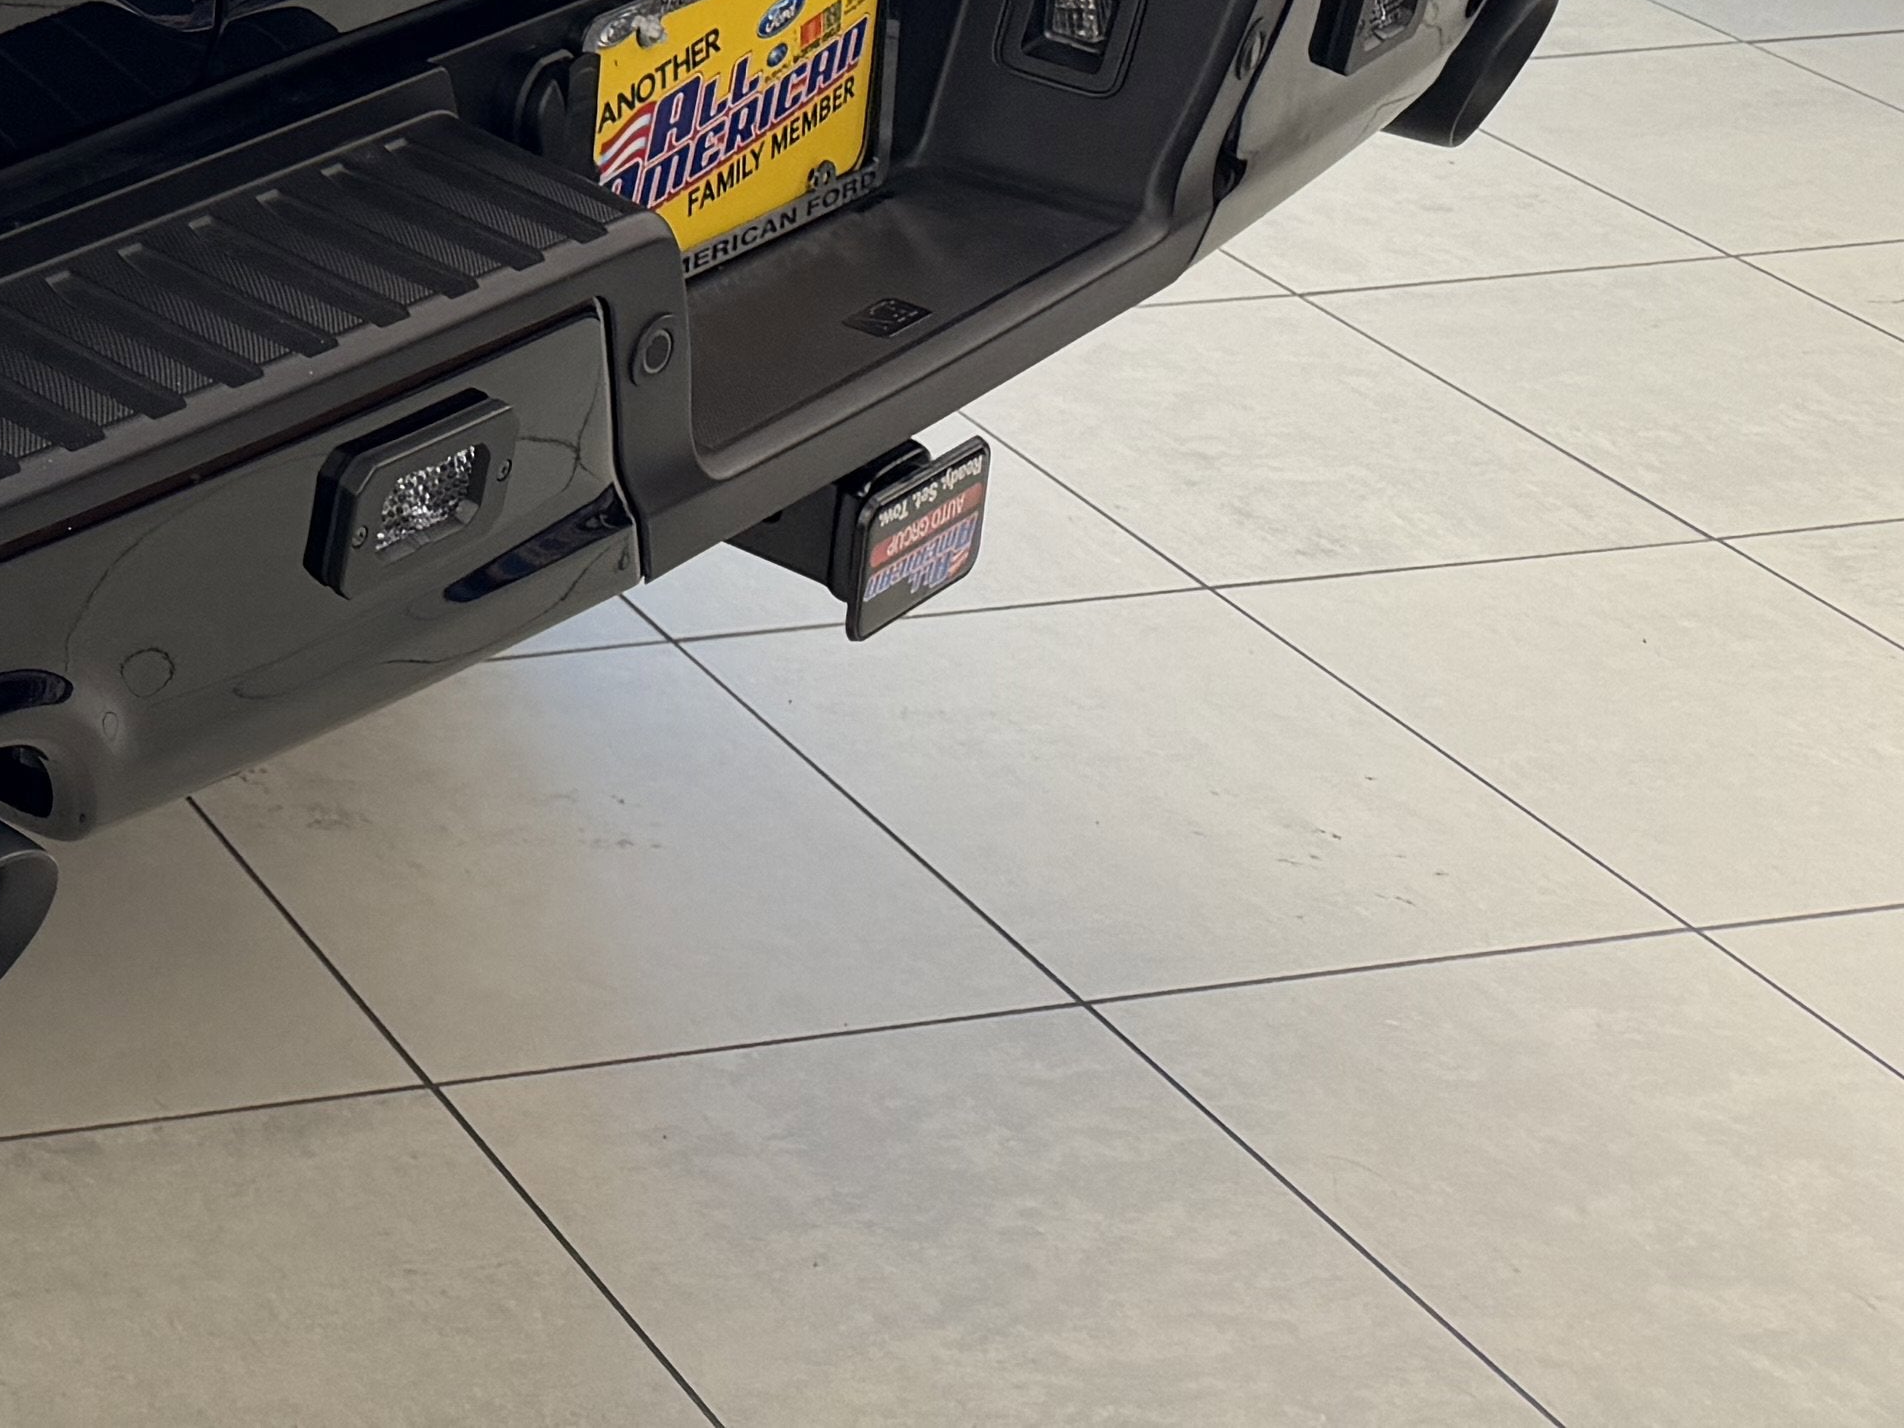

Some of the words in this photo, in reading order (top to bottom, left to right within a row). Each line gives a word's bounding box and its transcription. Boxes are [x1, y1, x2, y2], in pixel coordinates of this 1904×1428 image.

[597, 27, 722, 134] ANOTHER
[645, 51, 764, 163] ALL
[687, 147, 765, 217] FAMILY
[770, 76, 855, 161] MEMBER
[683, 205, 798, 274] ERICAN
[806, 170, 877, 217] FORD
[886, 518, 929, 557] GROUP
[931, 493, 966, 529] AUTO
